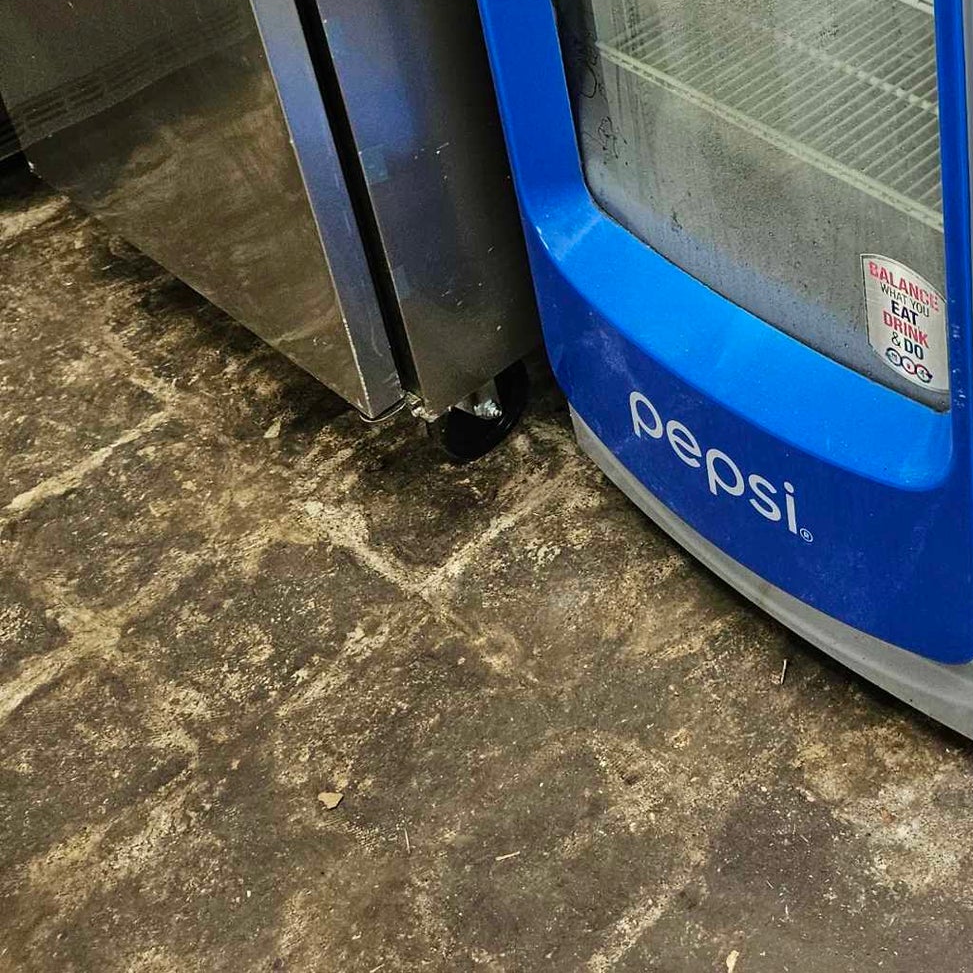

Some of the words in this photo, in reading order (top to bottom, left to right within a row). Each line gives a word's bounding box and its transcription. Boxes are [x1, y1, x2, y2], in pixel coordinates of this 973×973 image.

[868, 260, 940, 313] BALANCE
[880, 281, 908, 305] WHAT
[910, 297, 930, 318] YOU
[883, 309, 930, 349] DRINK
[891, 299, 919, 326] EAT
[891, 331, 901, 348] &
[904, 340, 924, 361] DO
[629, 390, 798, 536] pepsi
